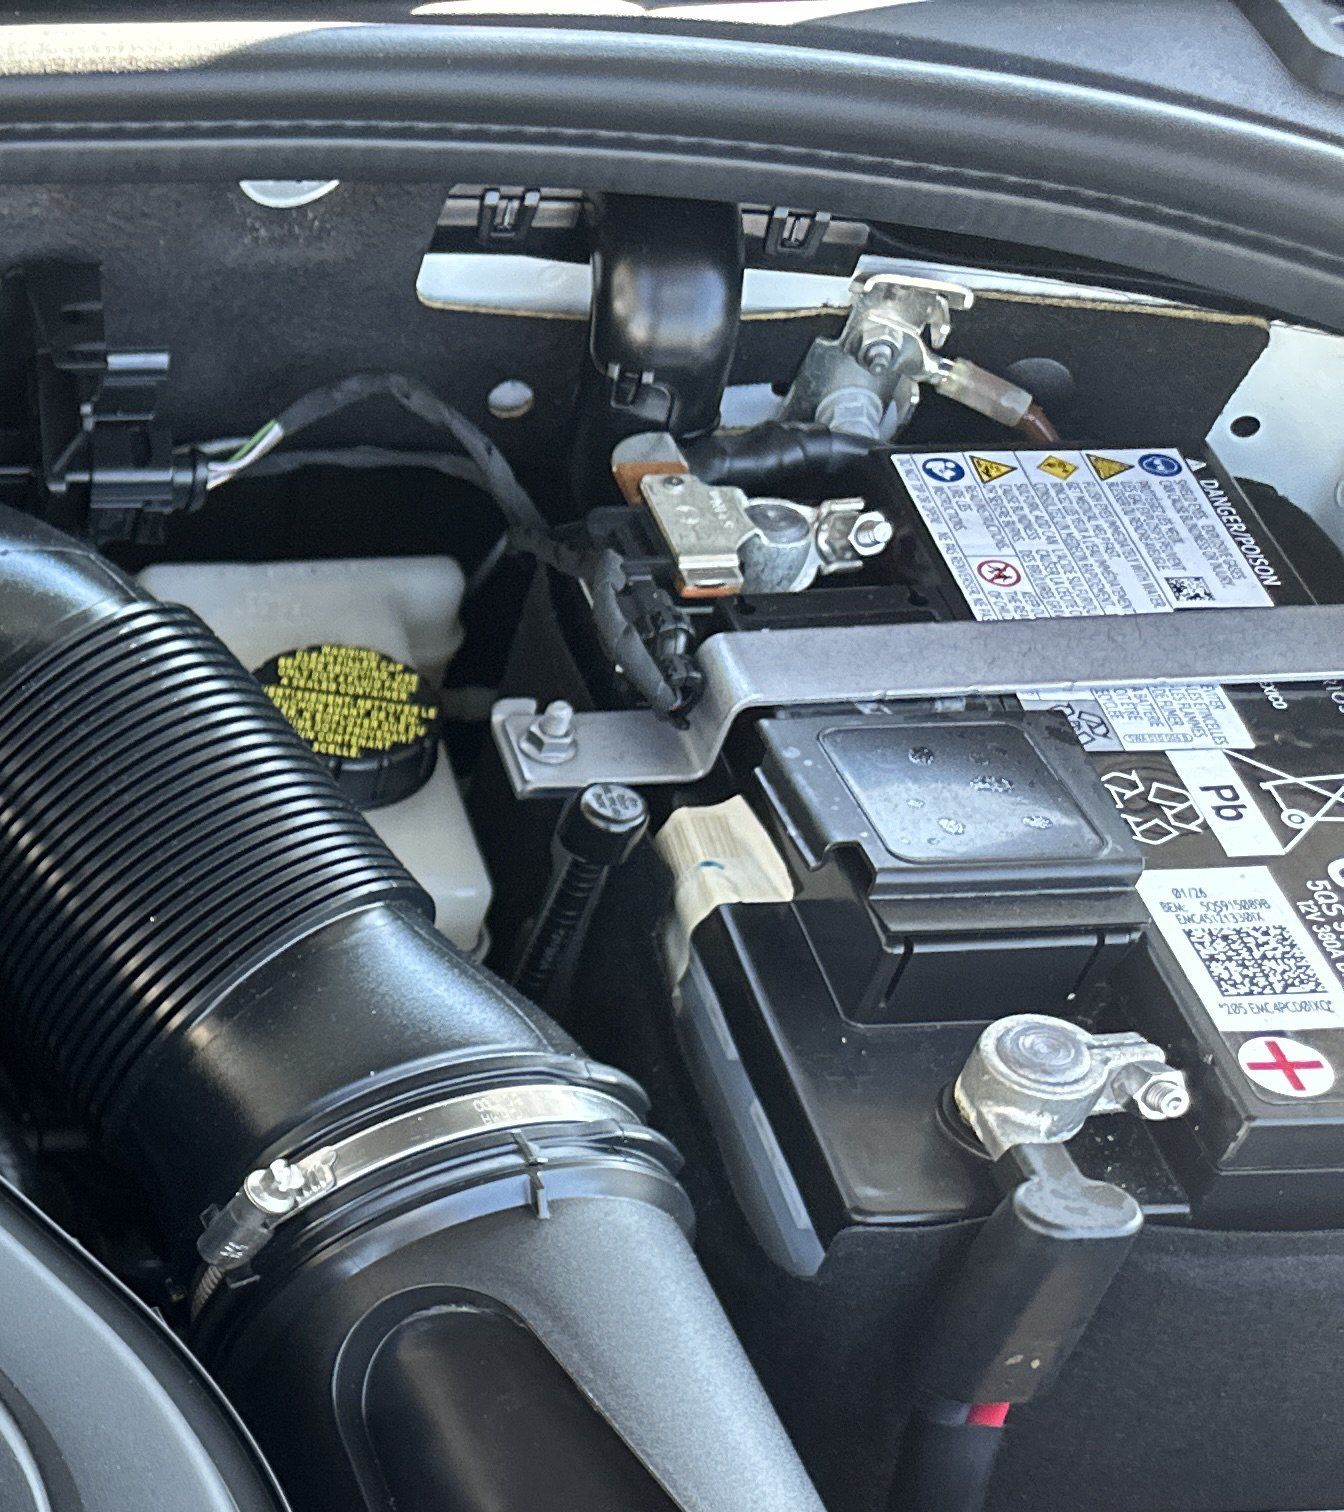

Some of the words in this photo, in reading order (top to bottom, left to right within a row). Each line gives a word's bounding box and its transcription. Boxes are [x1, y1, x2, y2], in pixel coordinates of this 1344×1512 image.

[1200, 479, 1281, 587] DANGER/POISON
[1199, 784, 1244, 821] Pb
[1296, 900, 1325, 923] 12V
